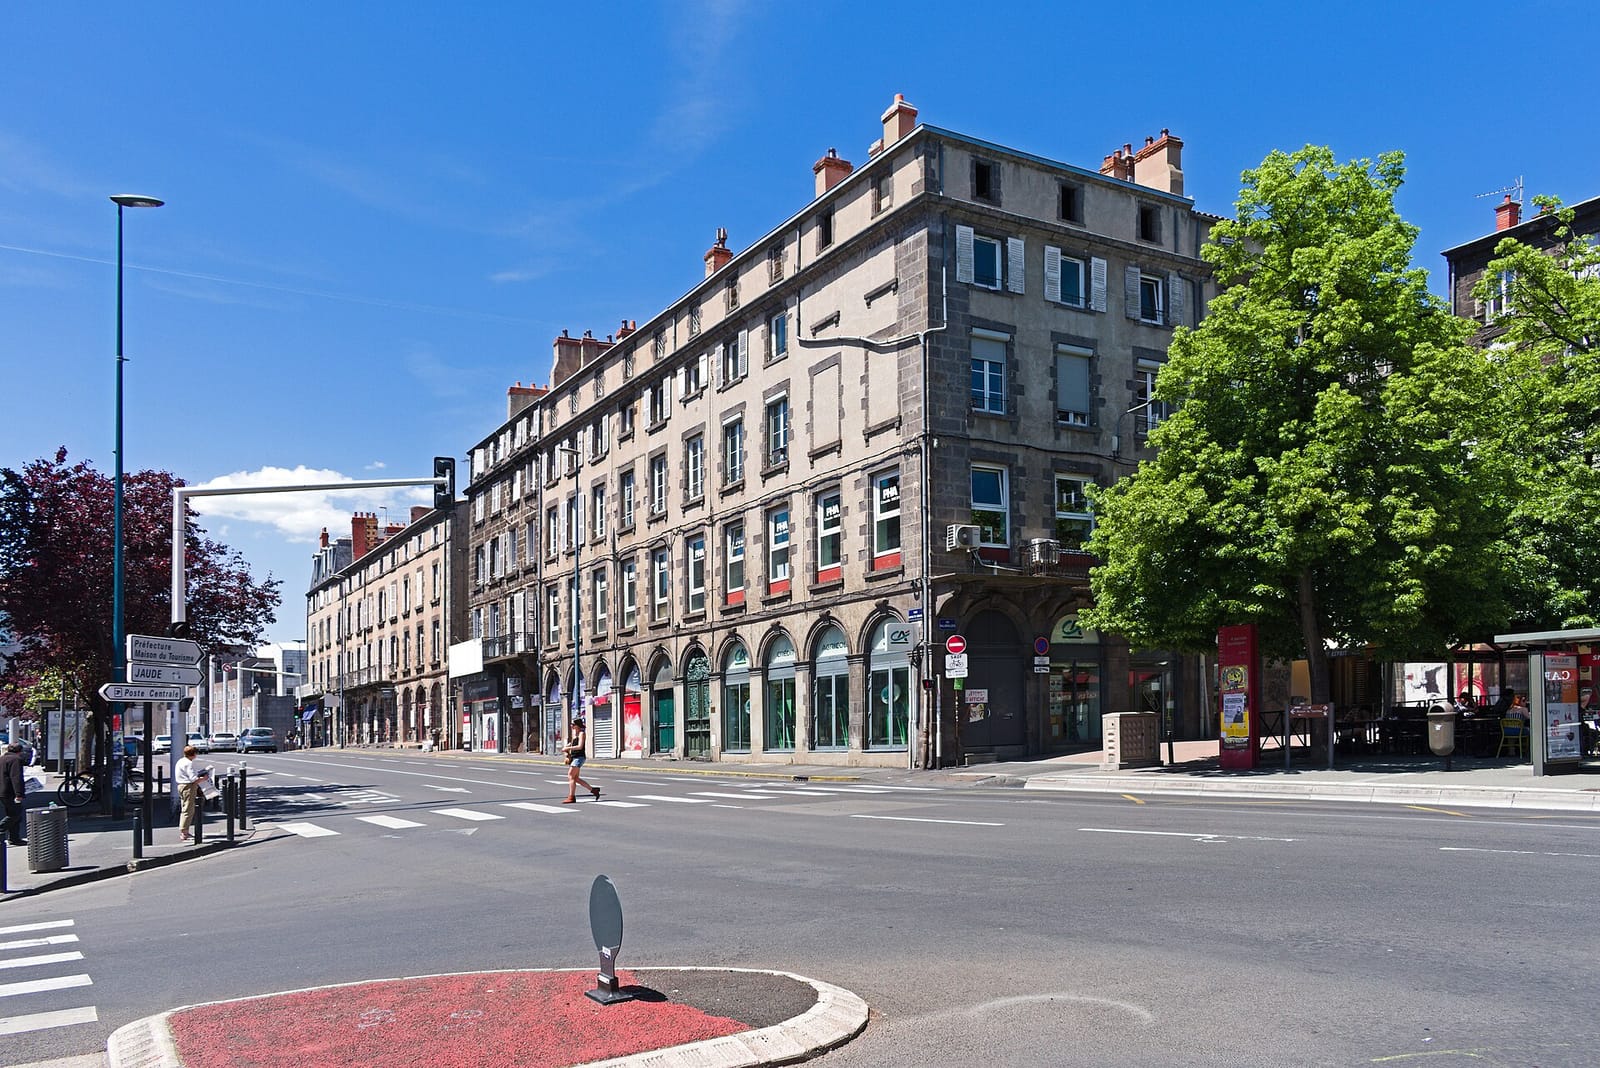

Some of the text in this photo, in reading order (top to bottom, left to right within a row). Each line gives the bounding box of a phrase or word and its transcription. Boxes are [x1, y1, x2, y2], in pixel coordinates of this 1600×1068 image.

[135, 640, 171, 651] Préfecture
[135, 650, 194, 662] Maison du Tourisme
[135, 668, 162, 679] JAUDE
[124, 688, 179, 698] Poste Centrale
